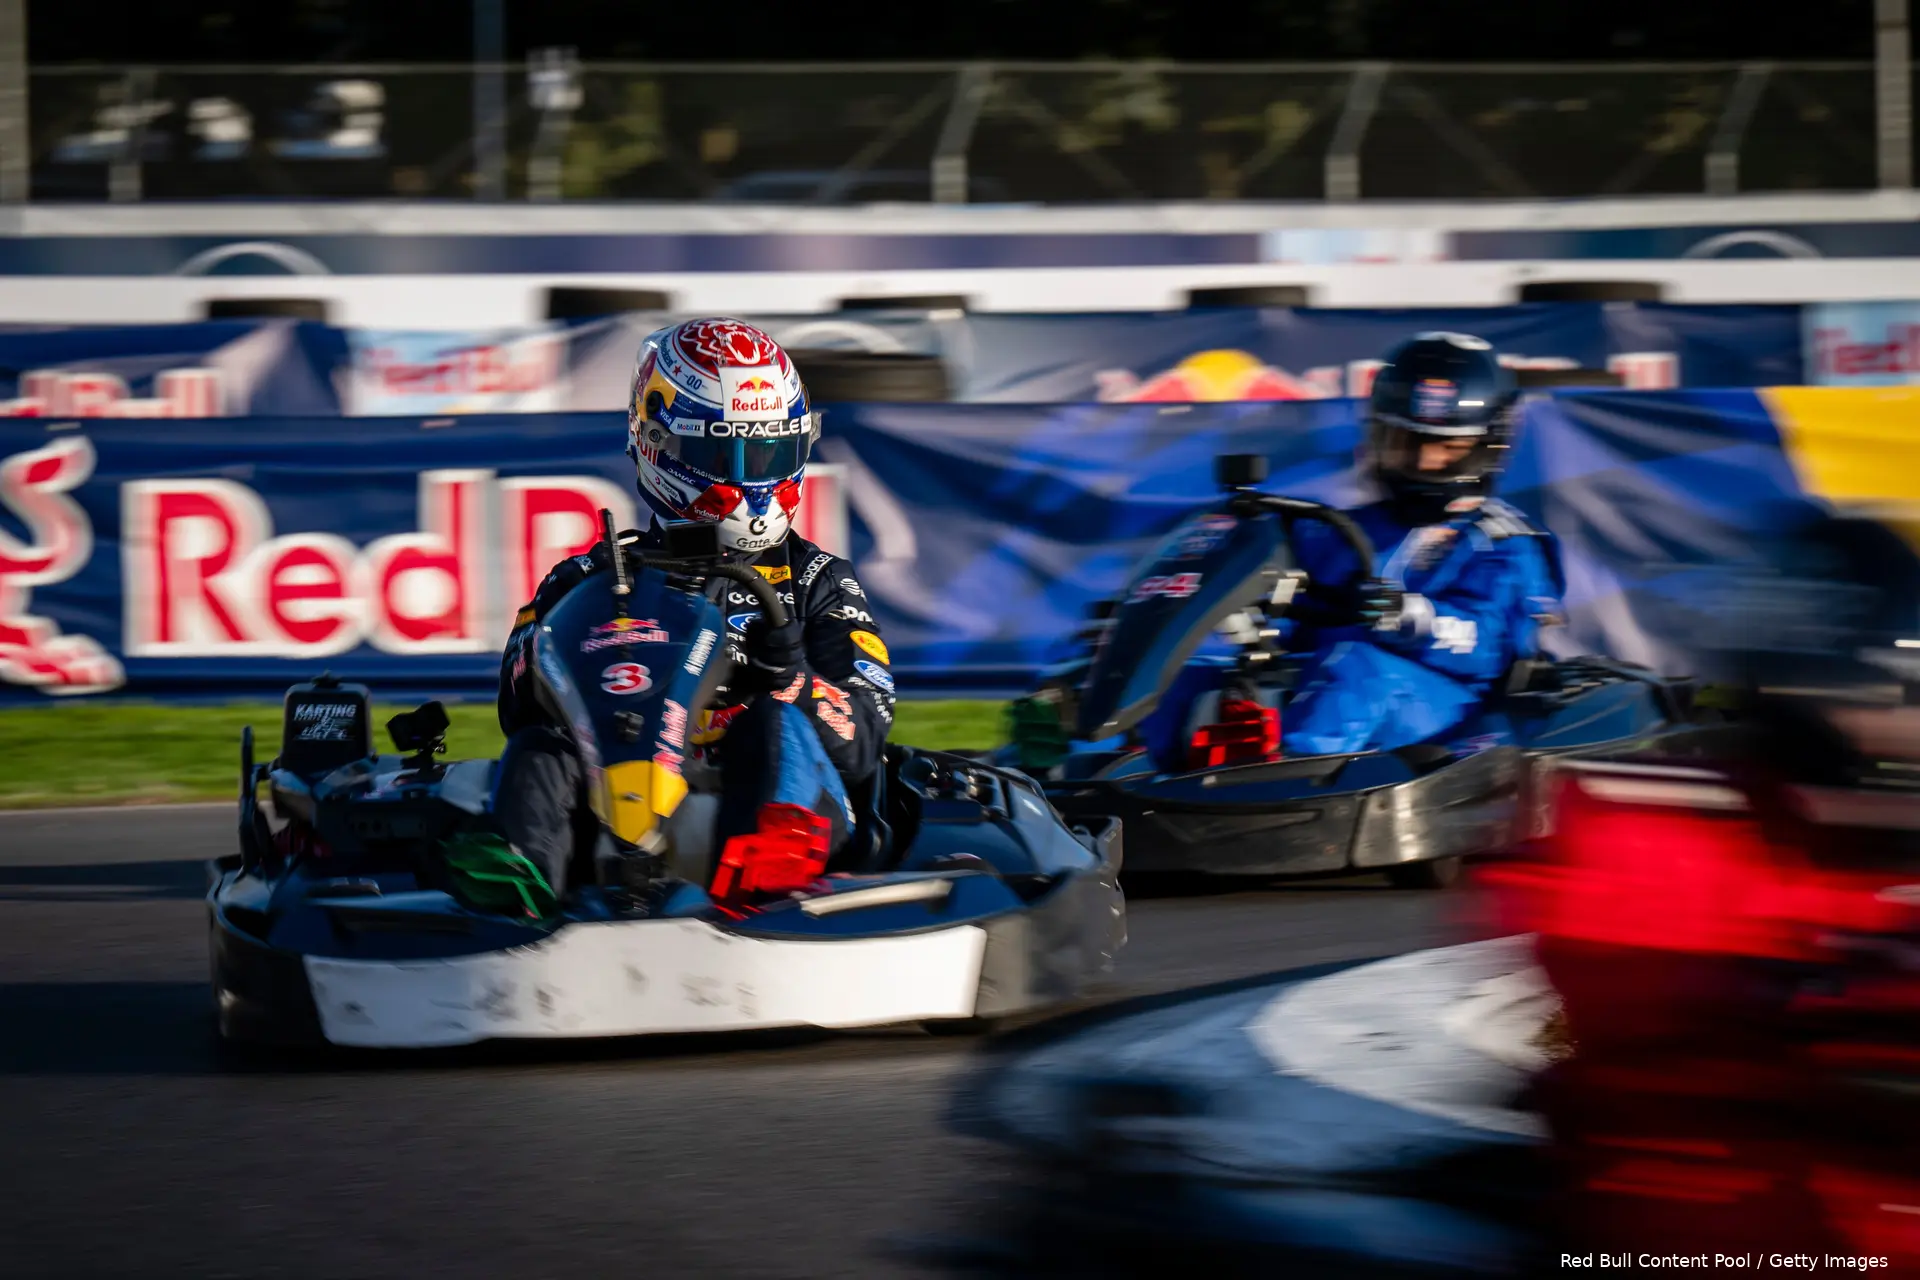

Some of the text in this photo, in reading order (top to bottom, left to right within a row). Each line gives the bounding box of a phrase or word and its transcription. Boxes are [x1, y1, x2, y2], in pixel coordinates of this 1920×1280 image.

[732, 396, 783, 411] Red Bull
[660, 408, 673, 425] VISA
[676, 423, 694, 432] Mobil
[709, 418, 800, 438] ORACLE
[667, 467, 697, 486] DAMAC
[736, 537, 771, 549] Gate
[123, 468, 498, 656] Red
[798, 553, 832, 587] sparco
[600, 661, 653, 695] 3
[293, 703, 357, 721] KARTING
